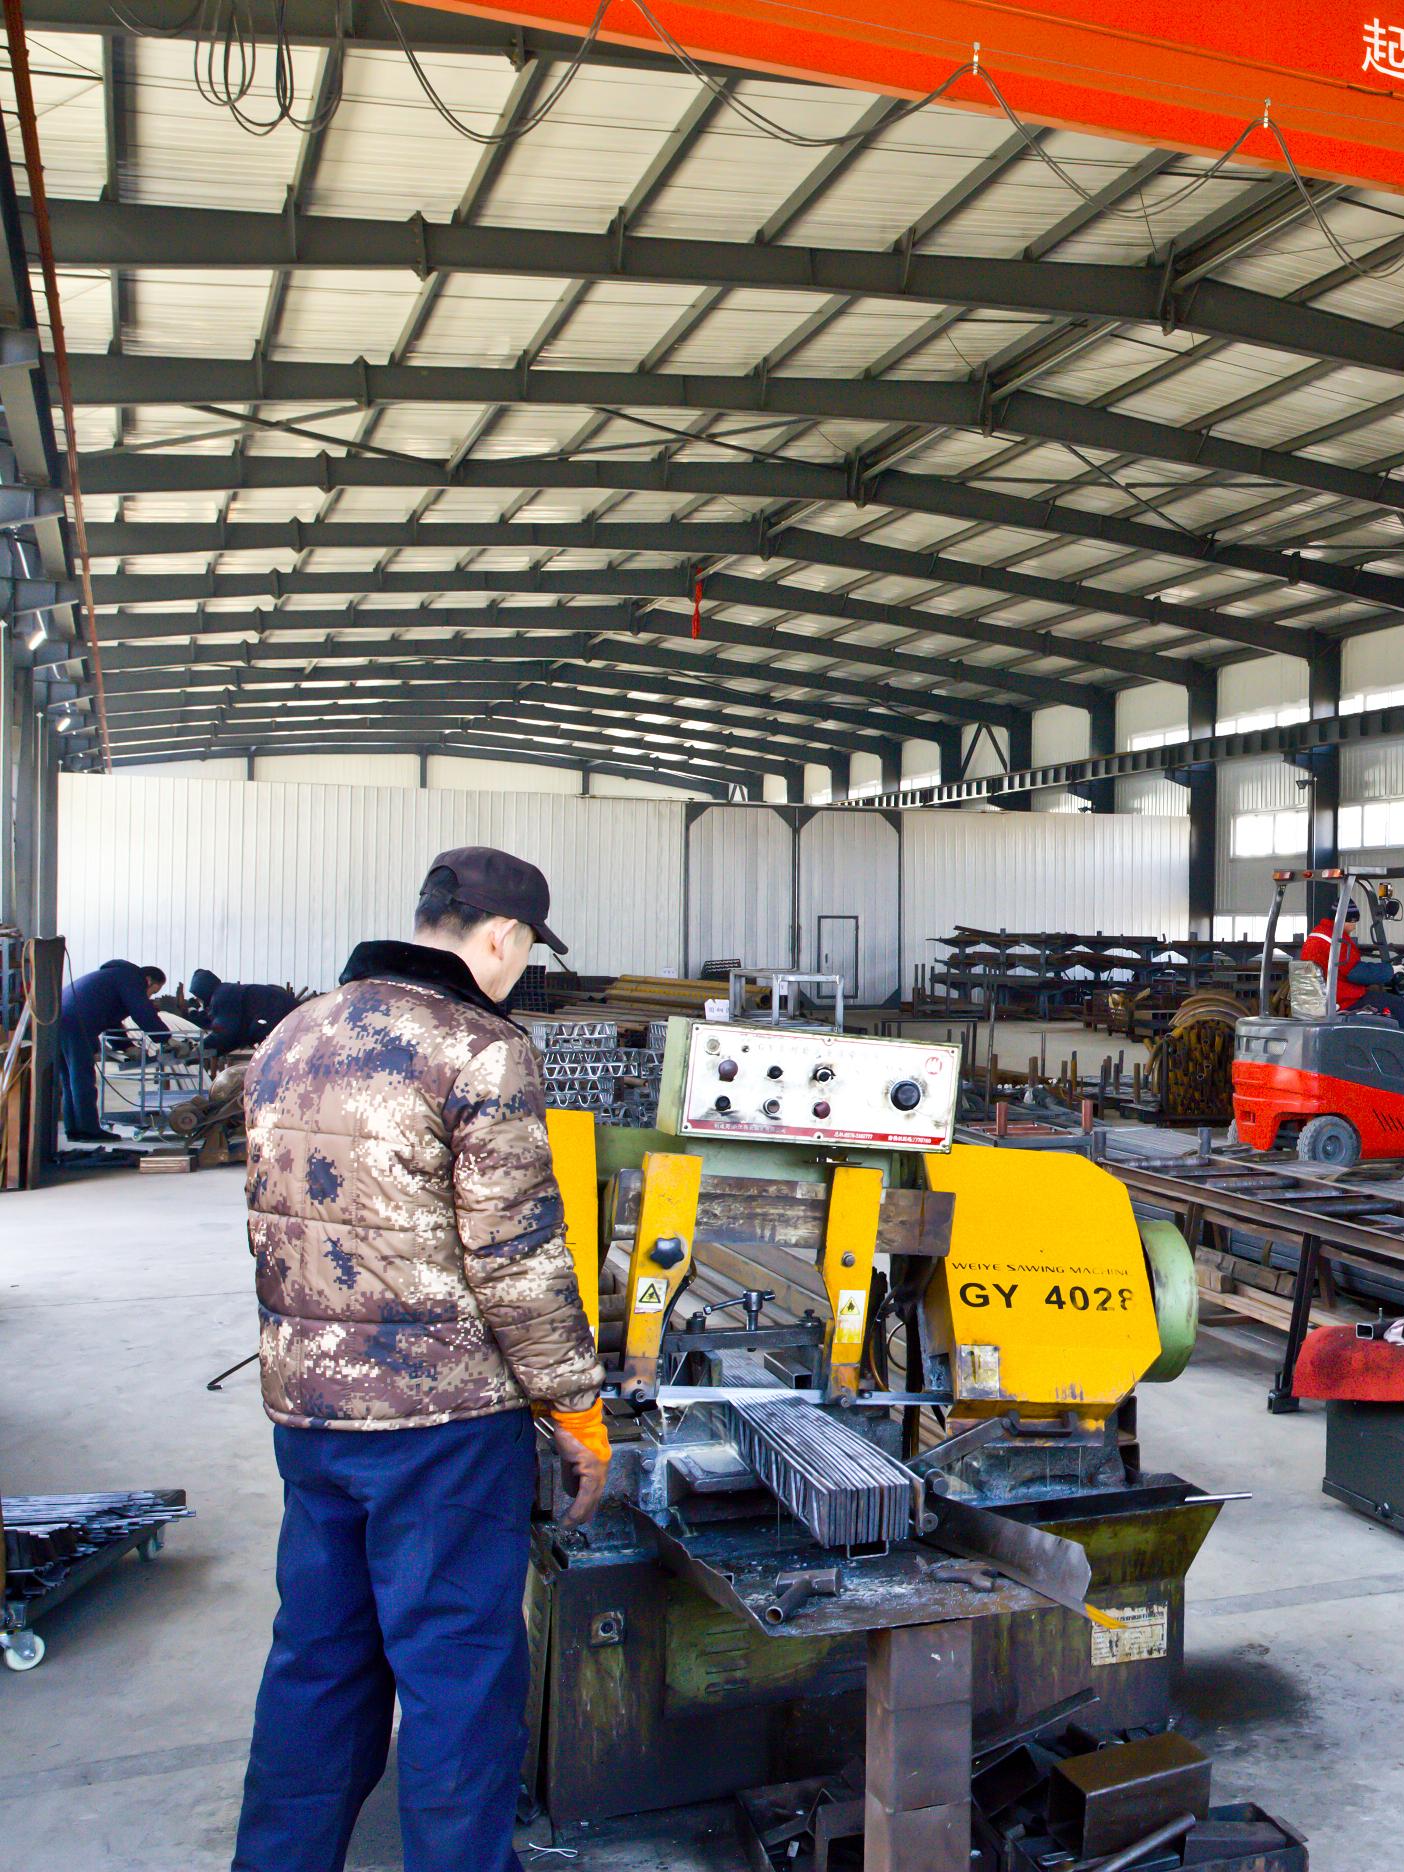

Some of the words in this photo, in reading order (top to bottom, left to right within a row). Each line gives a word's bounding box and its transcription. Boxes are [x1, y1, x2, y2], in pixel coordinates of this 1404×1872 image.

[952, 1262, 1001, 1272] WEIYE
[1006, 1264, 1065, 1274] SAWING
[959, 1282, 1018, 1309] GY
[1044, 1285, 1135, 1312] 4028
